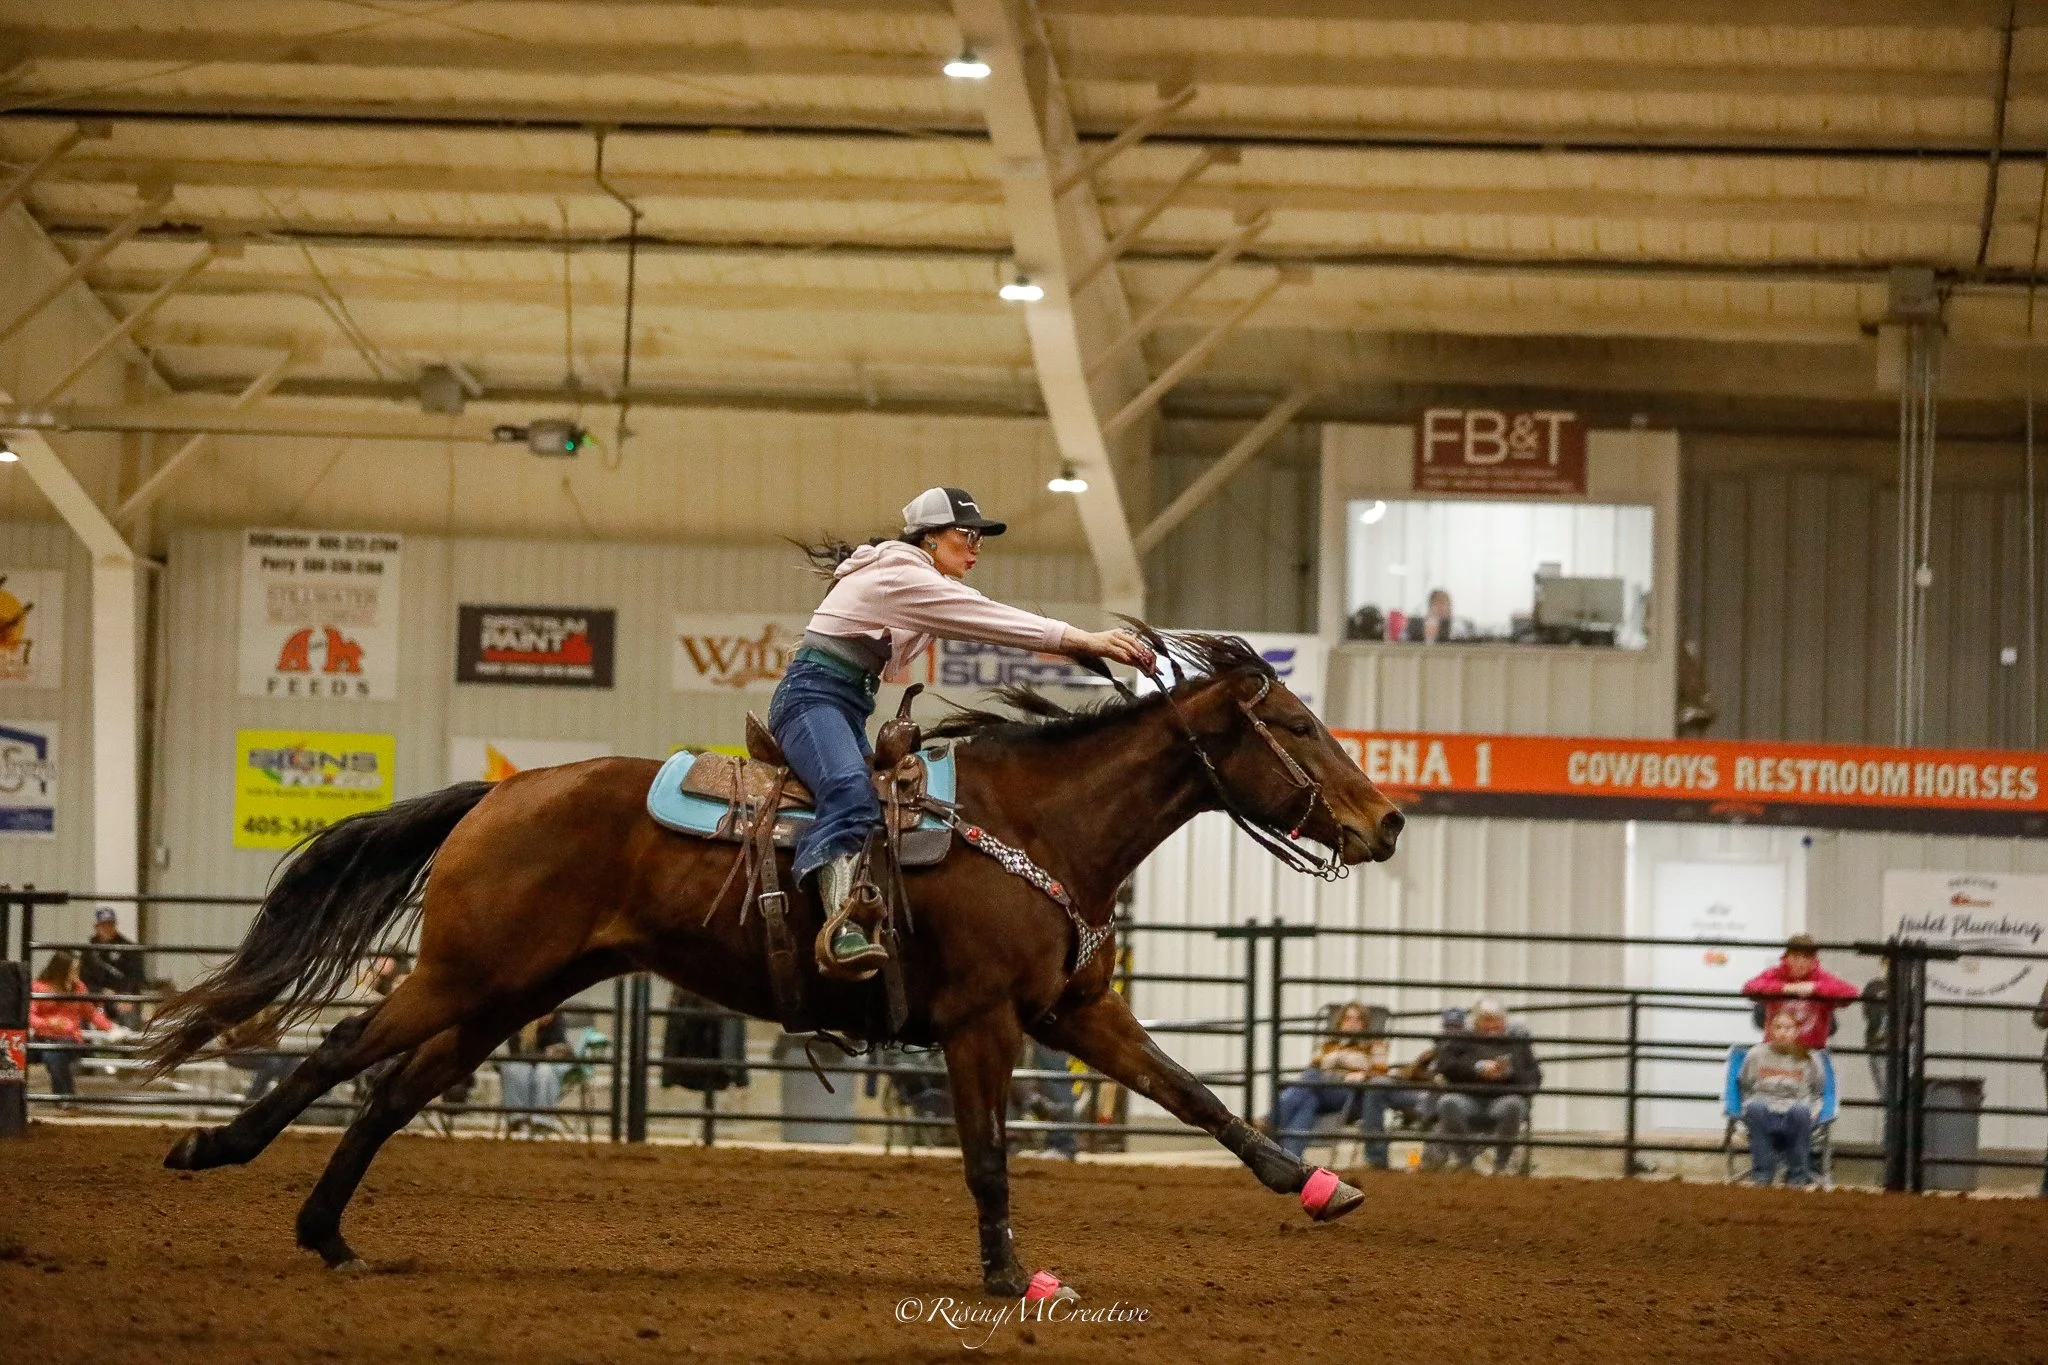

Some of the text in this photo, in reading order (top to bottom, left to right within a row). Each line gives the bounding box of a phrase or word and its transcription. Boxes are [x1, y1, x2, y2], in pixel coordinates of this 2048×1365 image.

[1423, 408, 1577, 466] FB&T
[480, 631, 563, 652] PAINT
[266, 677, 370, 697] FEEDS
[247, 747, 379, 772] SIGNS
[1475, 741, 1492, 787] 1
[1568, 751, 2039, 801] COWBOYS RESTROOM HORSES
[1950, 910, 2045, 945] Plumbing
